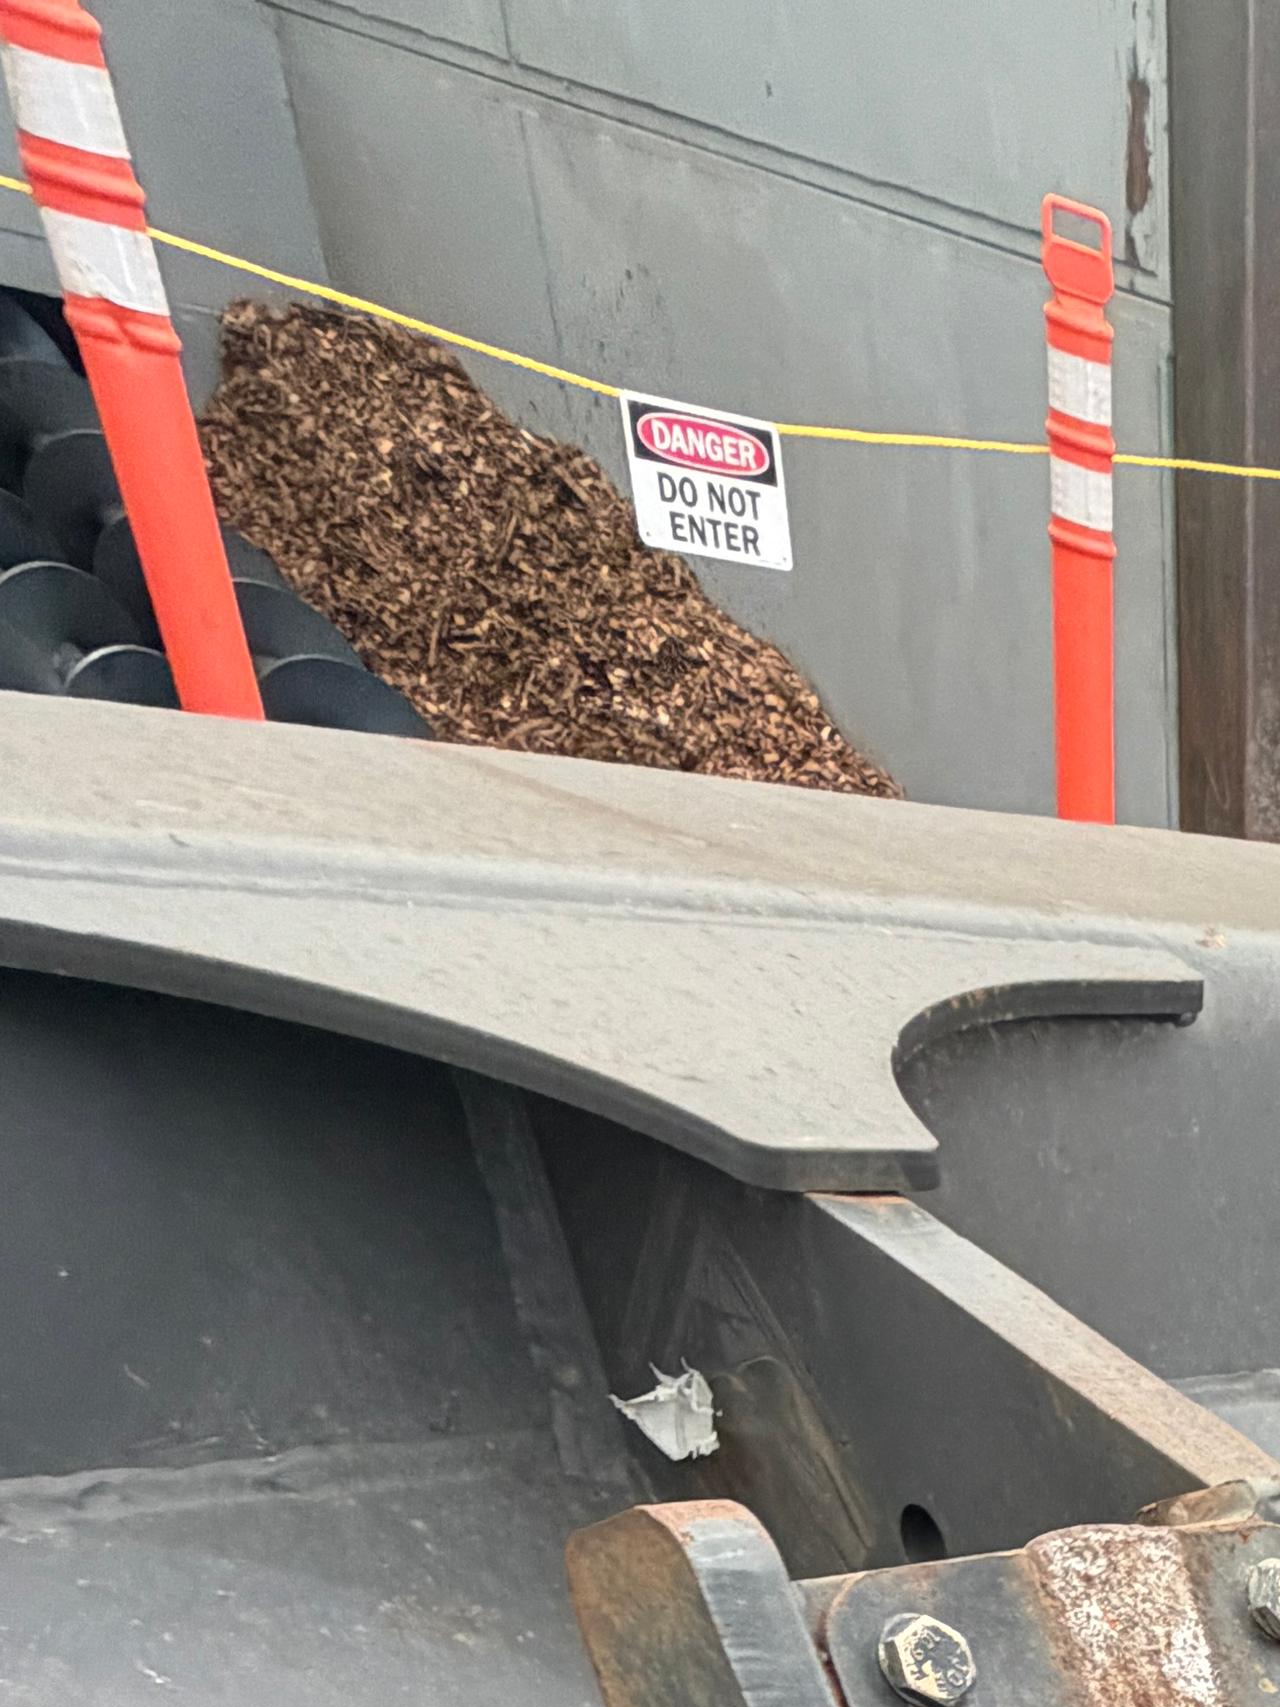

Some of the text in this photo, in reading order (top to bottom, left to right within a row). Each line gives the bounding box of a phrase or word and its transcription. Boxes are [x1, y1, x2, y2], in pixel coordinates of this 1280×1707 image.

[651, 419, 758, 470] DANGER
[657, 471, 761, 520] DO NOT
[669, 511, 761, 556] ENTER
